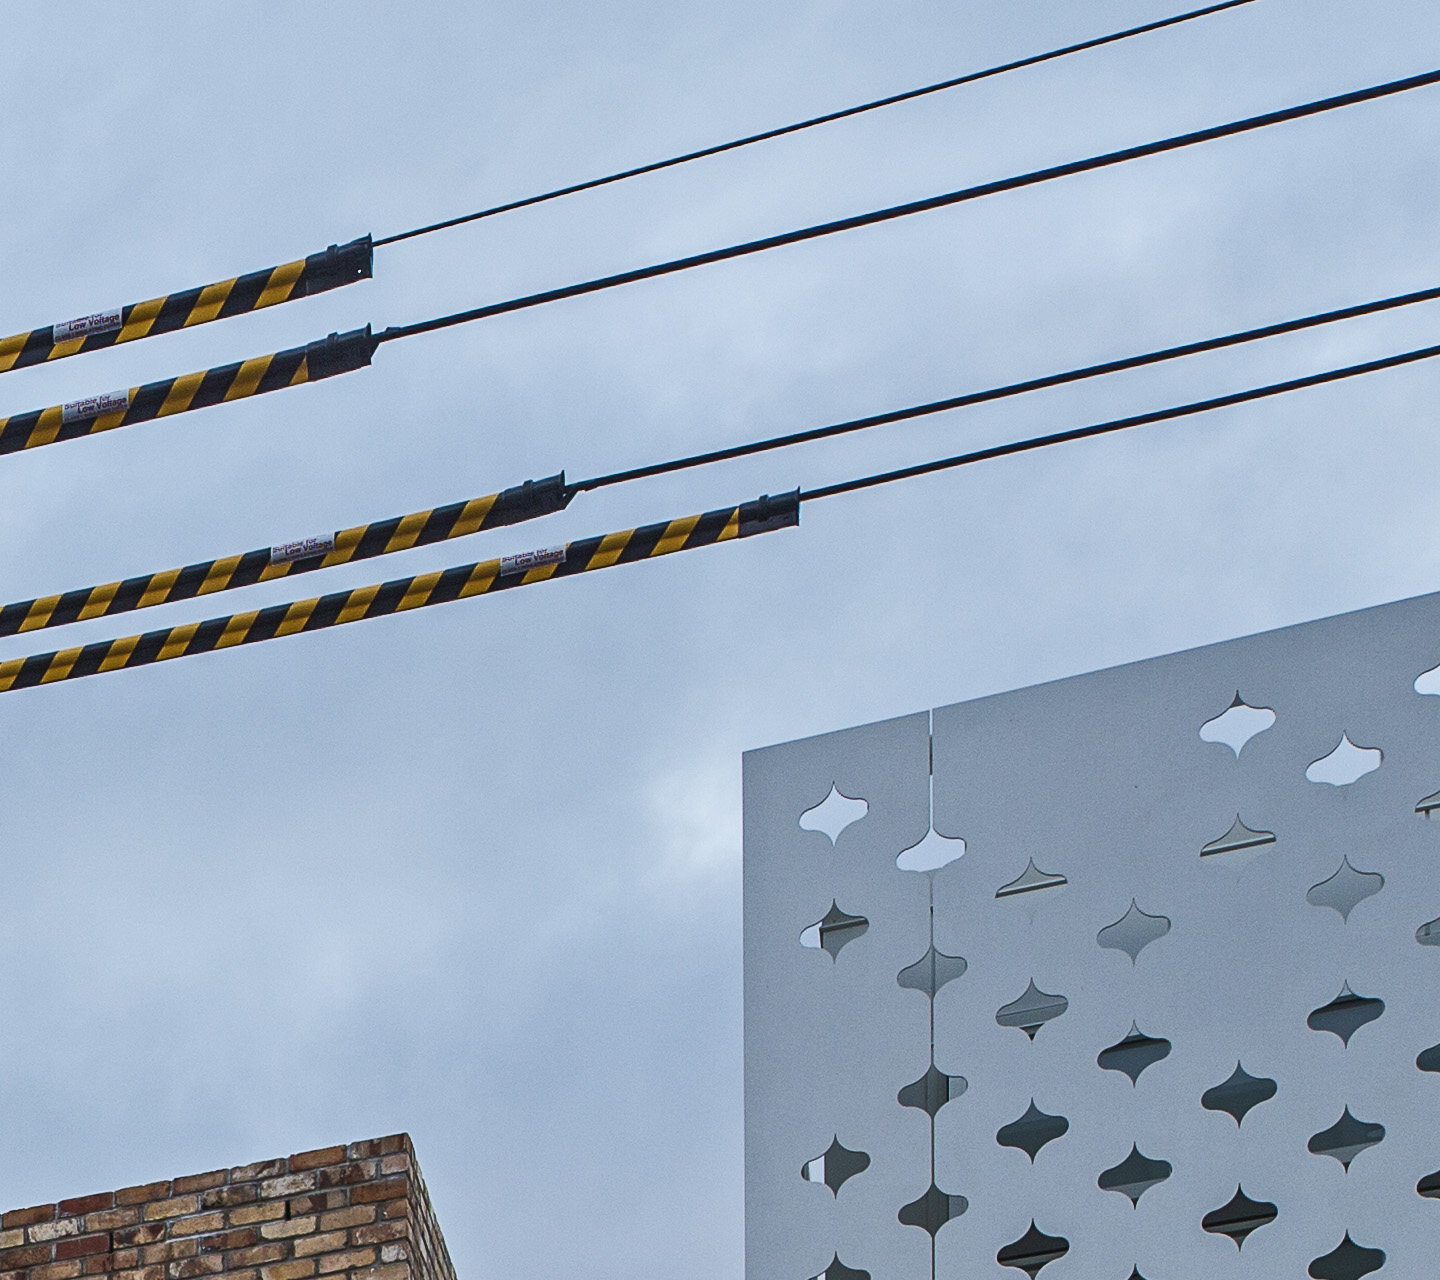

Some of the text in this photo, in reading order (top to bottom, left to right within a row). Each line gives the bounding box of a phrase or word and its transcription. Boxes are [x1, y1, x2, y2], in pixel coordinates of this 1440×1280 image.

[68, 313, 120, 331] Low Voltage
[64, 398, 98, 410] Suitable
[77, 396, 127, 414] Low Voltage
[284, 539, 333, 556] Low Voltage
[514, 549, 564, 566] Low Voltage
